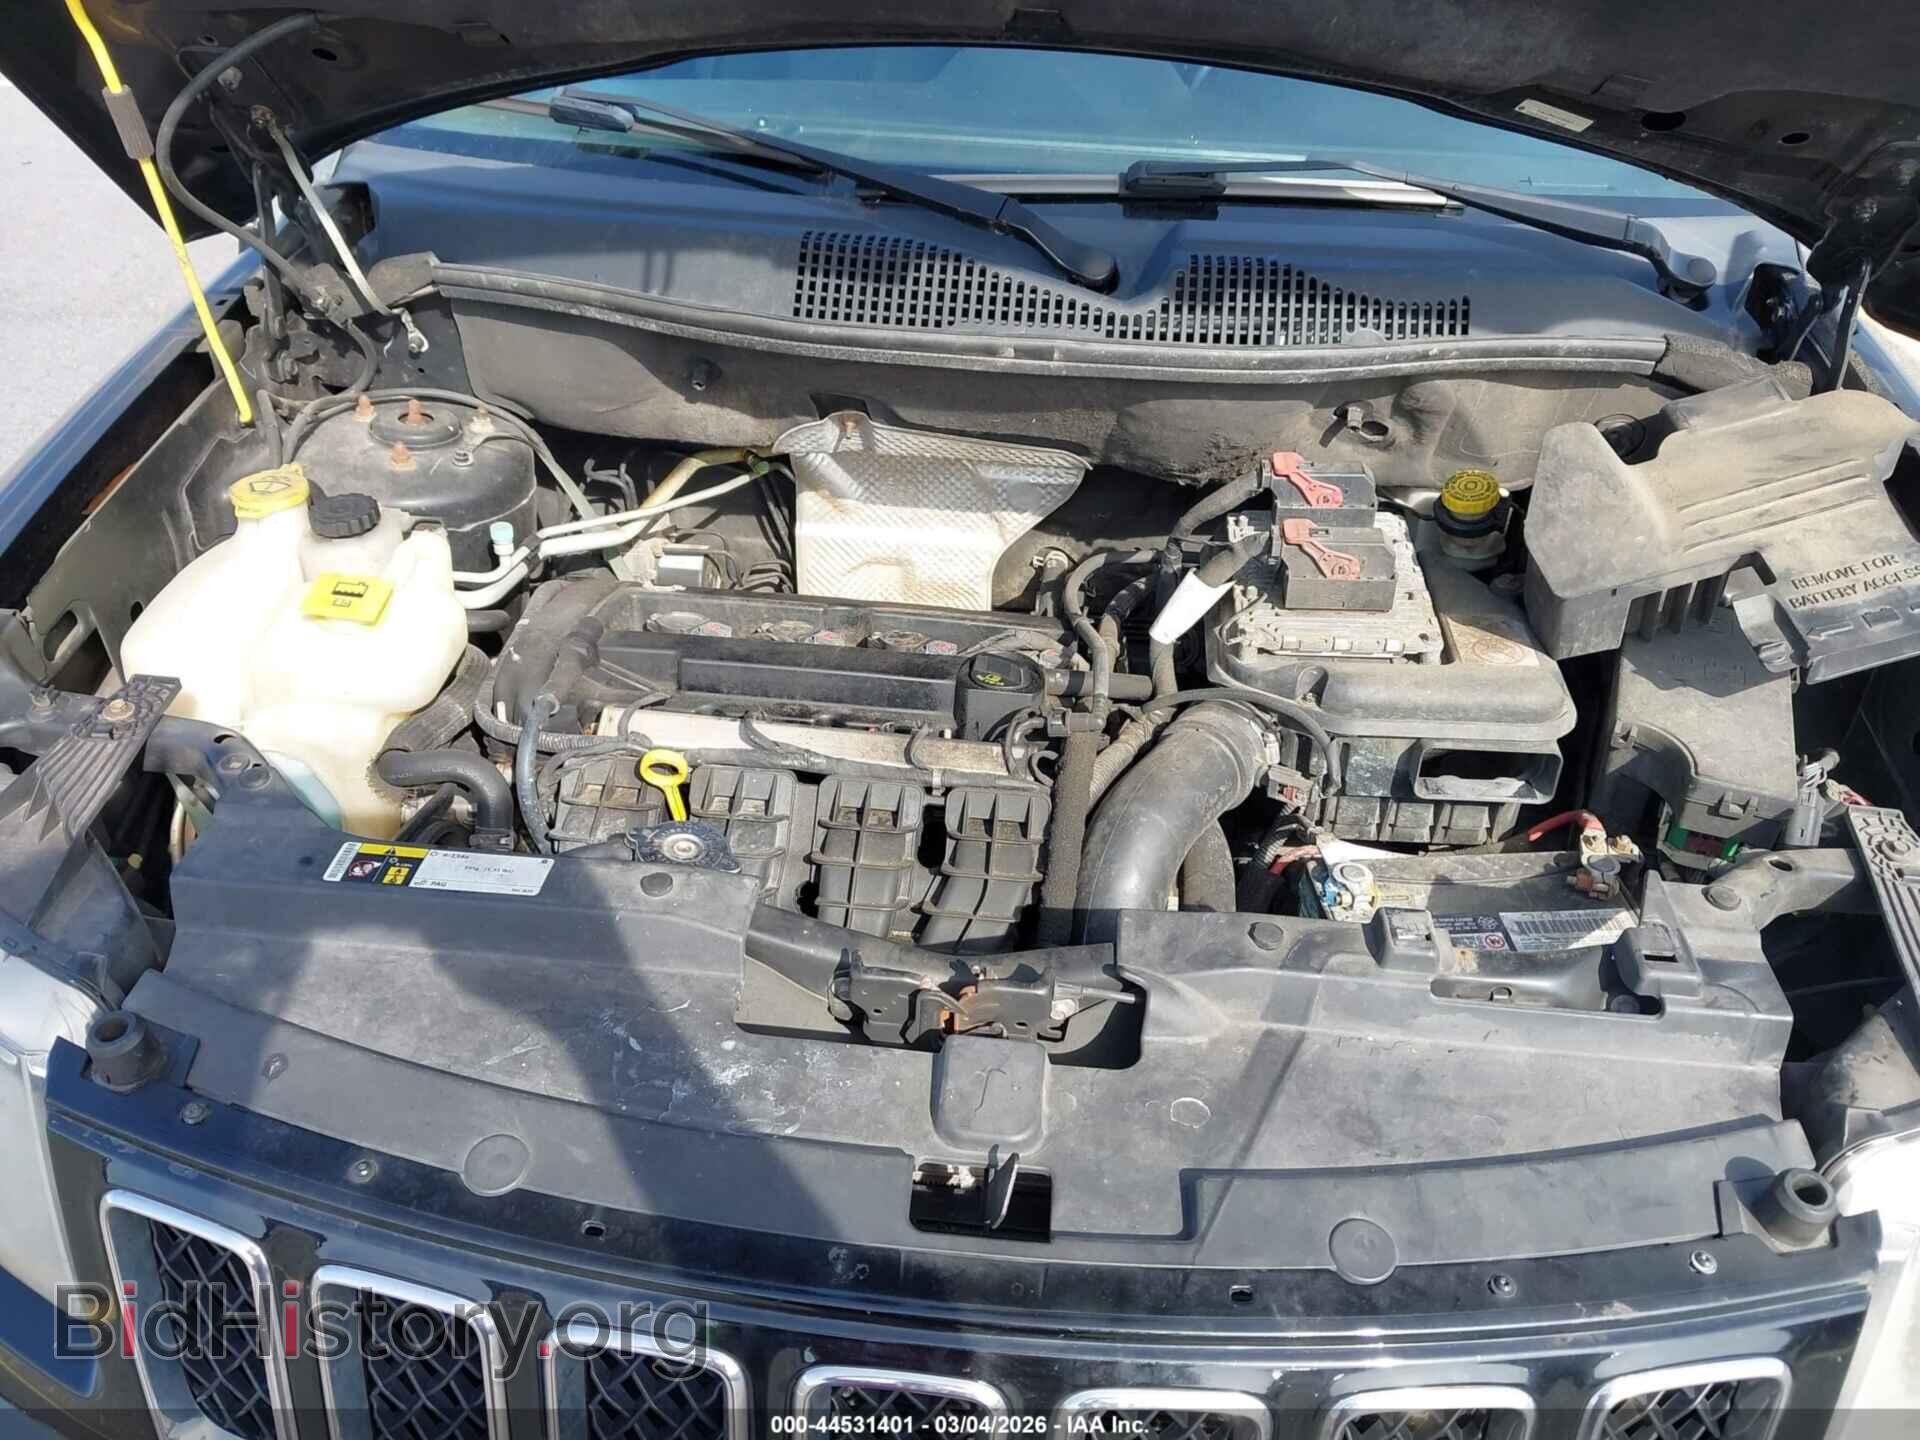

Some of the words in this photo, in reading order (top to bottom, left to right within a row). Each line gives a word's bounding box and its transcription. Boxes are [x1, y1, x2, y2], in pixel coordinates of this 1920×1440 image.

[1790, 565, 1858, 590] REMOVE
[1862, 554, 1899, 572] FOR
[1788, 583, 1858, 609] BATTERY
